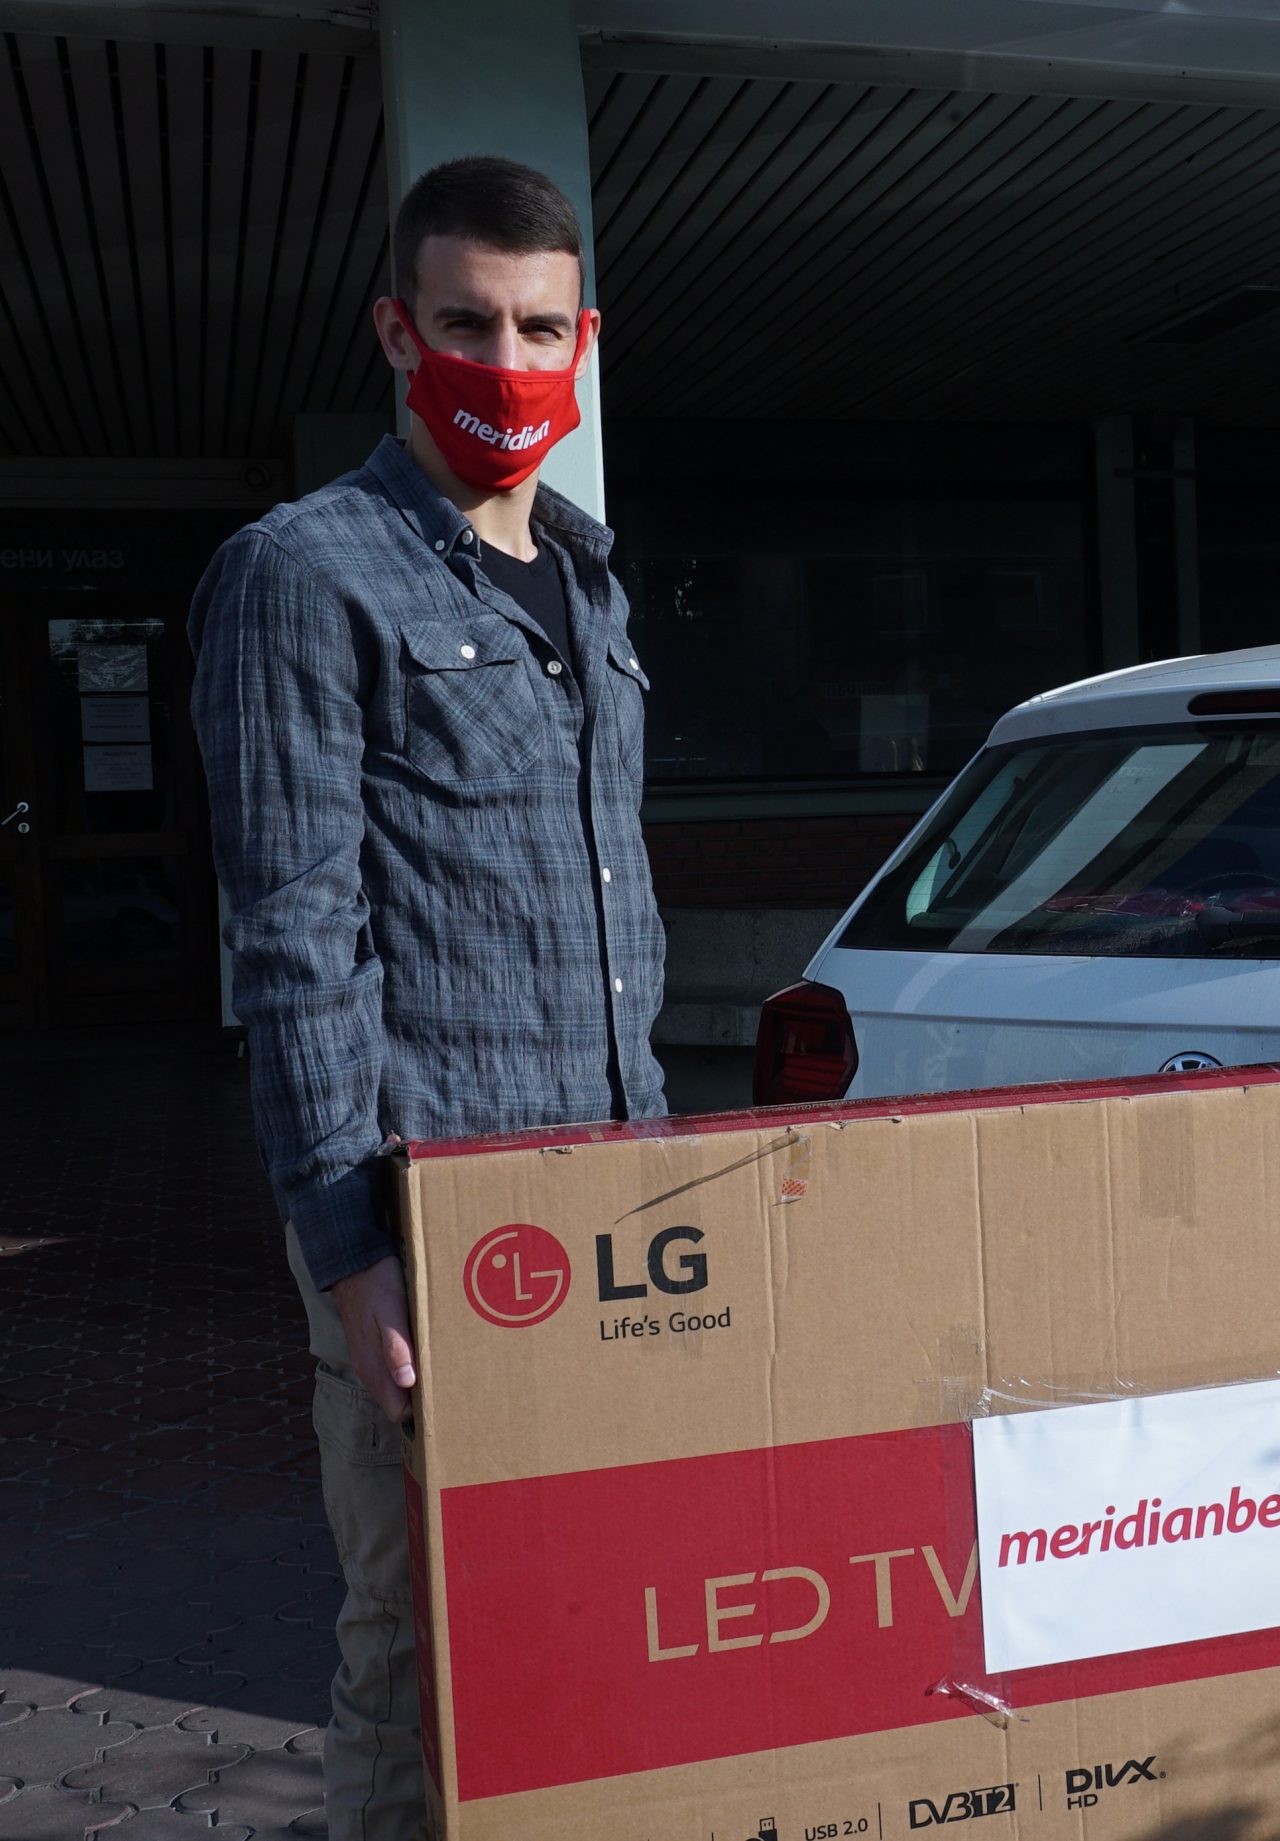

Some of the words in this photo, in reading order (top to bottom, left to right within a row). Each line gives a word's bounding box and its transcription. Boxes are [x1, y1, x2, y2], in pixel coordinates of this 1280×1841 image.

[453, 409, 550, 451] meridian
[63, 548, 125, 573] улаз
[596, 1226, 708, 1302] LG
[600, 1315, 661, 1341] Life's
[669, 1306, 731, 1333] Good
[644, 1566, 831, 1663] LED
[849, 1539, 979, 1629] TV
[1066, 1756, 1158, 1795] DIVX
[1067, 1794, 1099, 1810] HD
[804, 1825, 838, 1841] USB
[843, 1817, 868, 1835] 2.0
